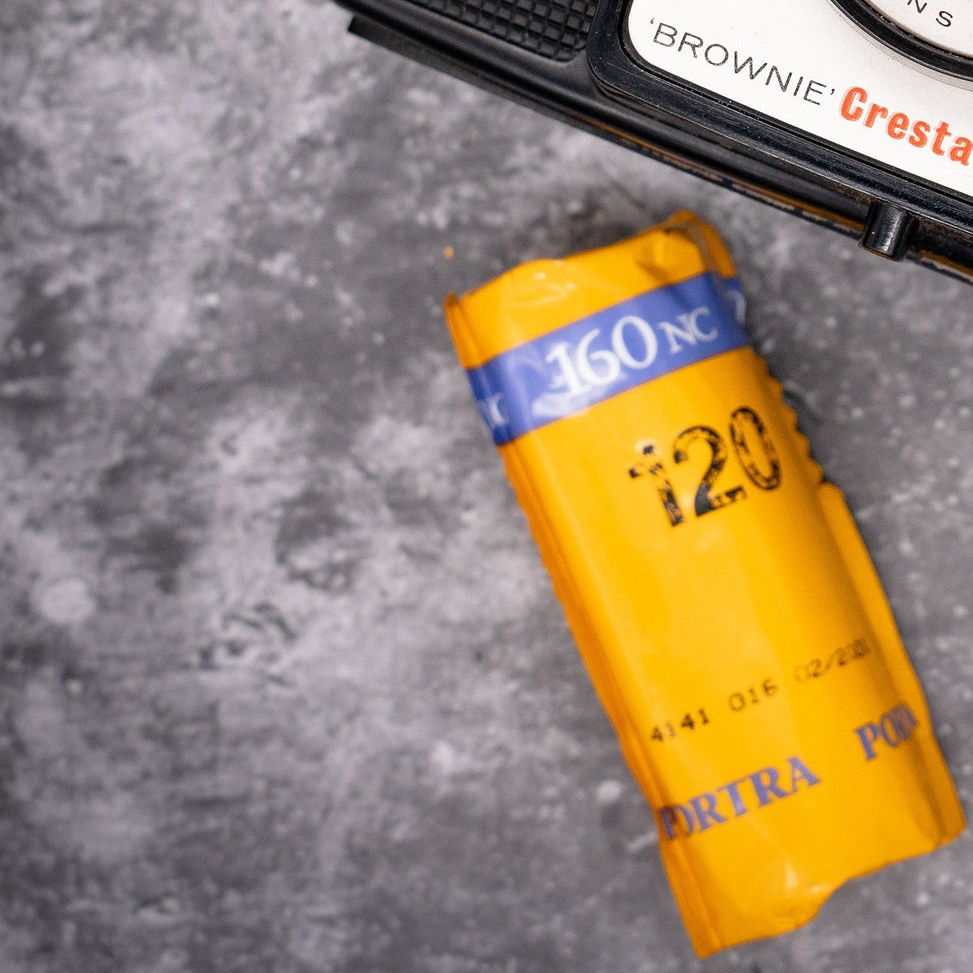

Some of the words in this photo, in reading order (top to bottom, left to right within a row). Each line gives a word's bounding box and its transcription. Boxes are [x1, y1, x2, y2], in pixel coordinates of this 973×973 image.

[648, 16, 837, 107] 'BROWNIE'
[545, 313, 659, 399] 160
[657, 305, 718, 355] NC
[627, 405, 783, 528] 120
[650, 706, 710, 743] 4141
